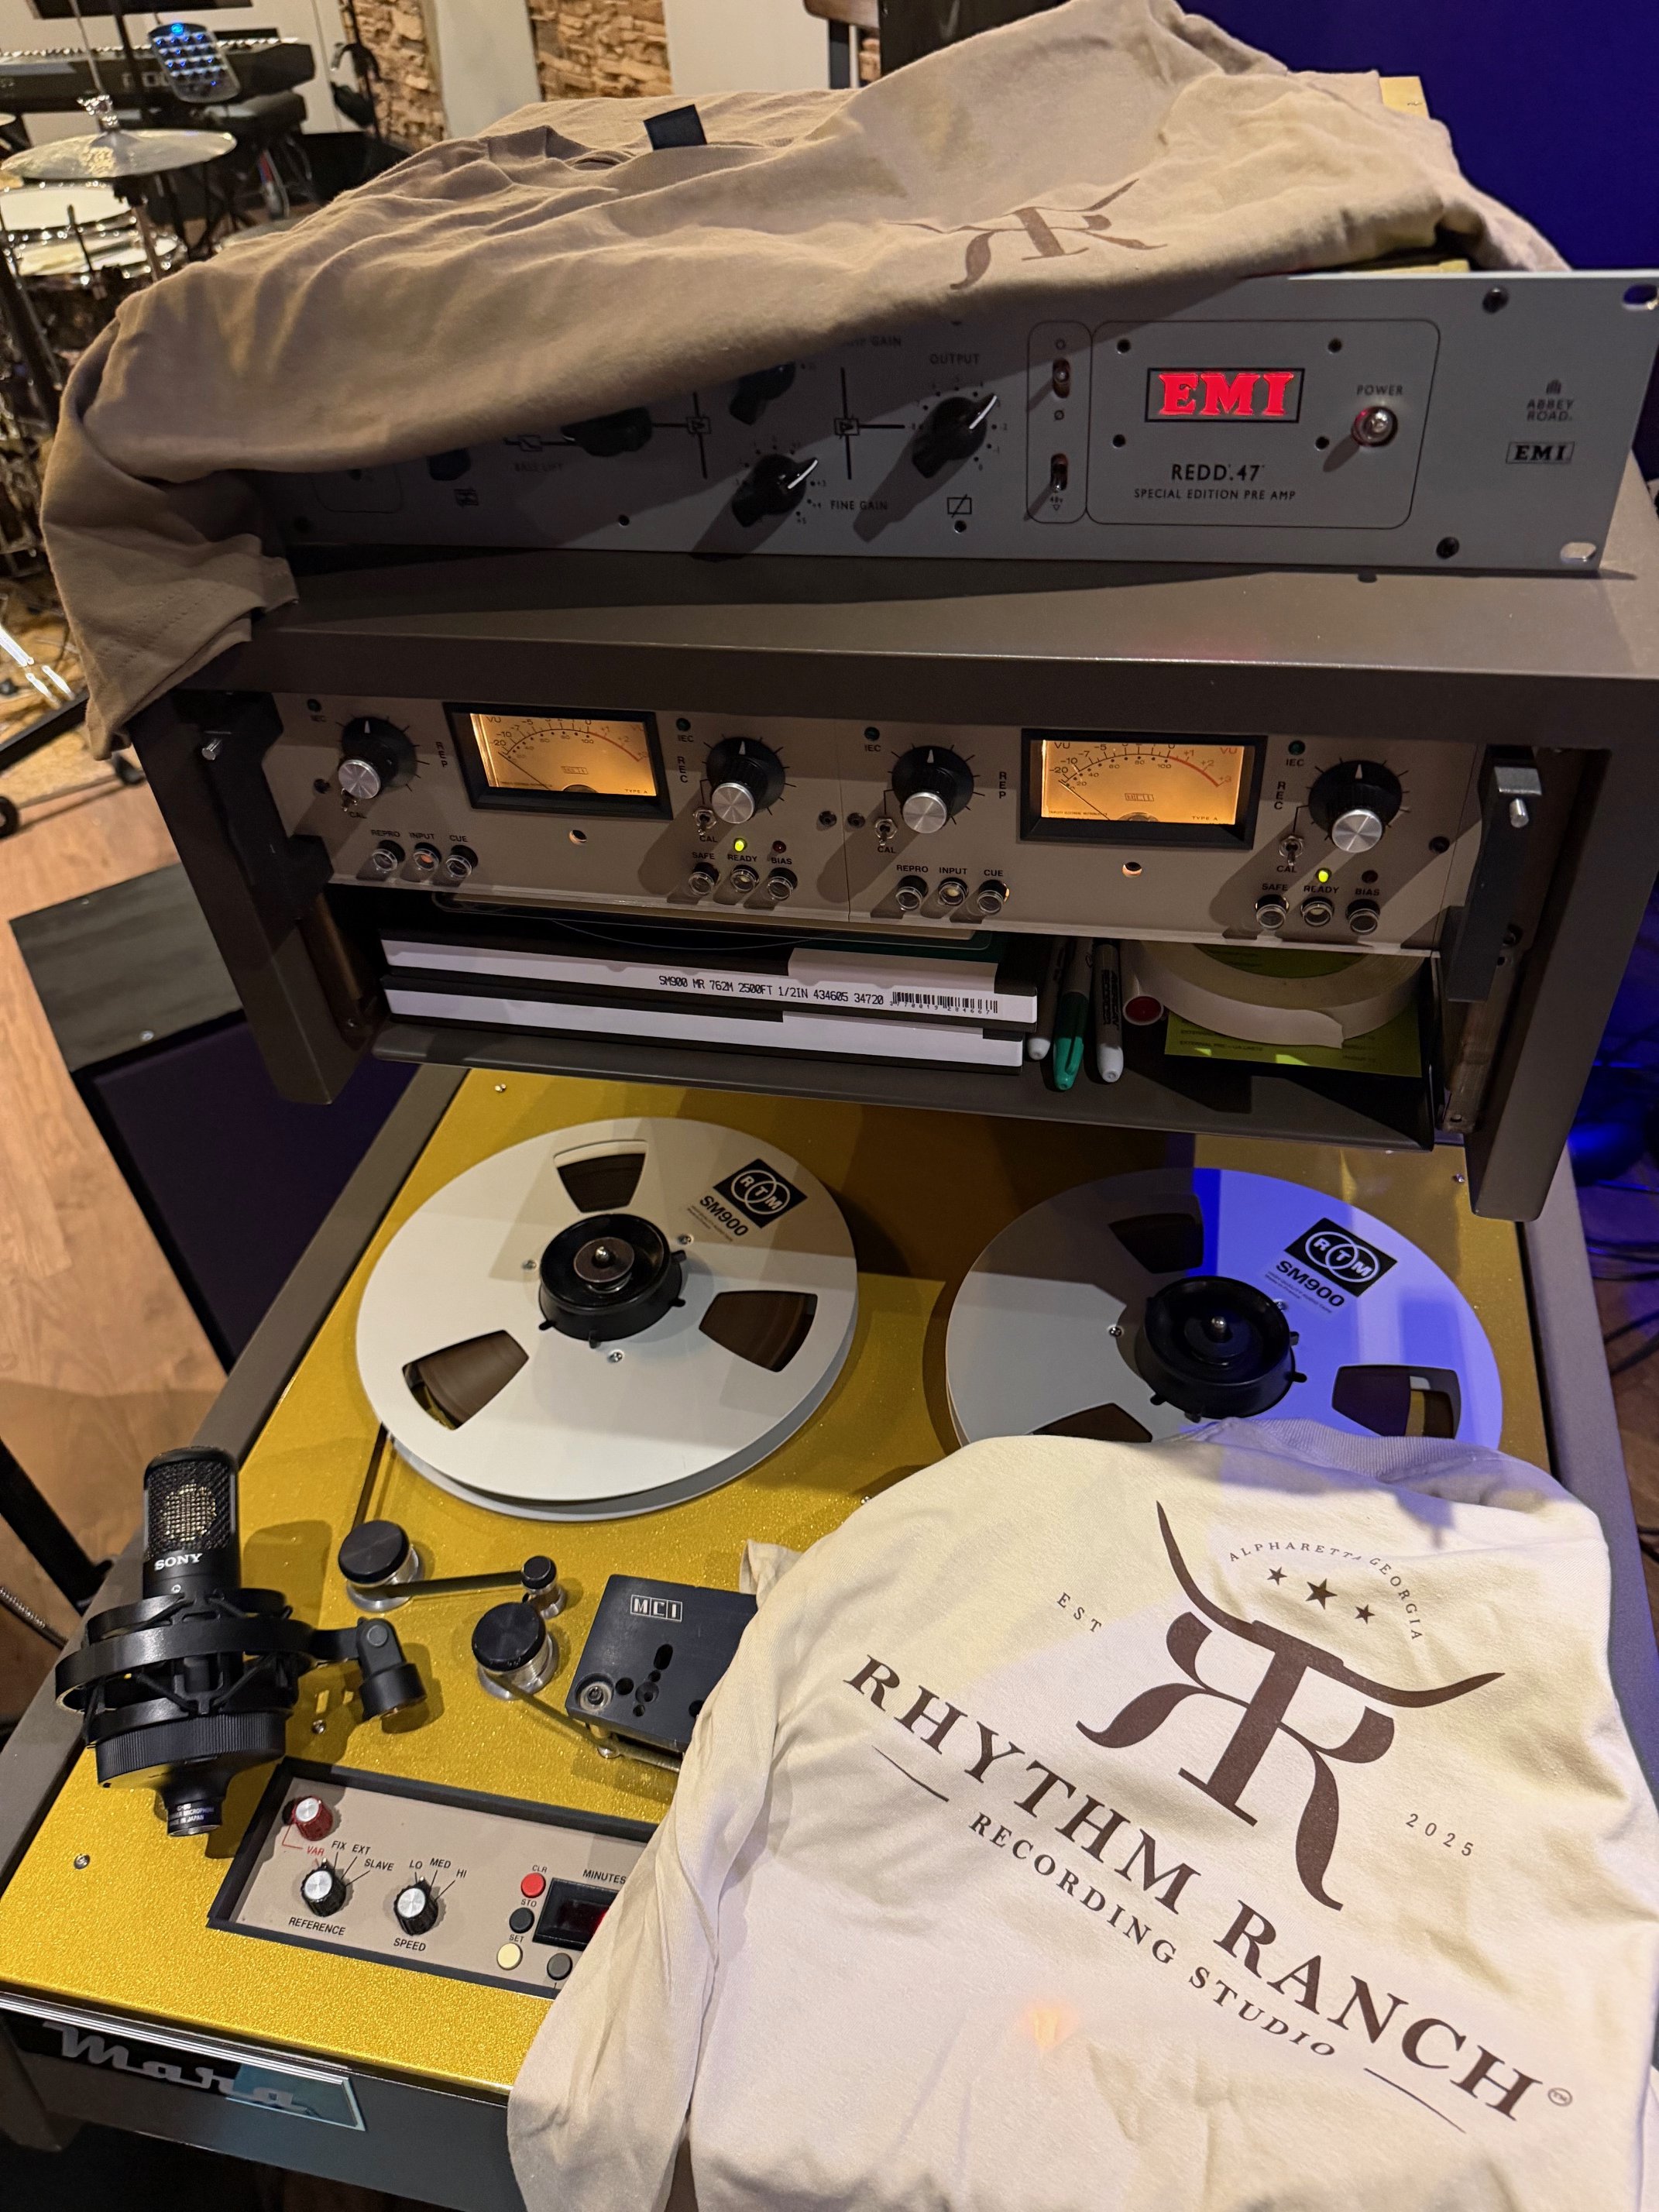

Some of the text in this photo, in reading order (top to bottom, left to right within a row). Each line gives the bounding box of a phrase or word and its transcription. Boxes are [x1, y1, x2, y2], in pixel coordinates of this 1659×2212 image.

[929, 353, 981, 365] OUTPUT
[1159, 372, 1295, 417] EMI
[1357, 384, 1403, 396] POWER
[1527, 398, 1574, 410] ABBEY
[1513, 444, 1567, 462] EMI
[1134, 488, 1296, 500] SPECIAL EDITION PRE AMP
[830, 500, 888, 510] FINE GAIN
[678, 734, 695, 743] IEC
[1054, 741, 1070, 750] VU
[436, 741, 448, 768] REP
[864, 744, 881, 753] IEC
[1219, 747, 1238, 755] VU
[1060, 757, 1078, 765] -10
[1286, 758, 1305, 767] IEC
[677, 756, 689, 783] REC
[998, 771, 1007, 799] REP
[1274, 781, 1286, 810] REC
[349, 811, 367, 819] CAL
[370, 829, 469, 843] REPRO INPUT CUE
[877, 845, 896, 854] CAL
[692, 852, 793, 866] SAFE READY BIAS
[896, 864, 929, 873] REPRO
[939, 867, 967, 875] INPUT
[1276, 865, 1297, 874] CAL
[1262, 883, 1380, 897] SAFE READY BIAS
[659, 975, 884, 1005] SM900 MR 762M 2500FT 1/2IN 434605 34720
[740, 1176, 784, 1211] RTM
[699, 1195, 749, 1237] SM900
[1313, 1238, 1373, 1277] RTM
[1276, 1260, 1345, 1307] SM900
[154, 1552, 203, 1571] SONY
[1229, 1541, 1423, 1640] ALPHARETTA GEORGIA
[633, 1596, 678, 1620] MCI
[1056, 1592, 1103, 1633] EST
[187, 1815, 205, 1823] JAPAN
[1405, 1812, 1475, 1858] 2025
[306, 1839, 395, 1871] VAR FIX EXT SLAVE
[409, 1858, 467, 1880] LO MED HI
[531, 1863, 548, 1874] CLR
[582, 1868, 627, 1885] MINUTES
[843, 1654, 1544, 2122] RHYTHM RANCH
[520, 1898, 538, 1908] STO
[288, 1916, 346, 1936] REFERENCE
[508, 1933, 525, 1944] SET
[968, 1812, 1336, 2057] RECORDING STUDIO
[393, 1937, 427, 1953] SPEED
